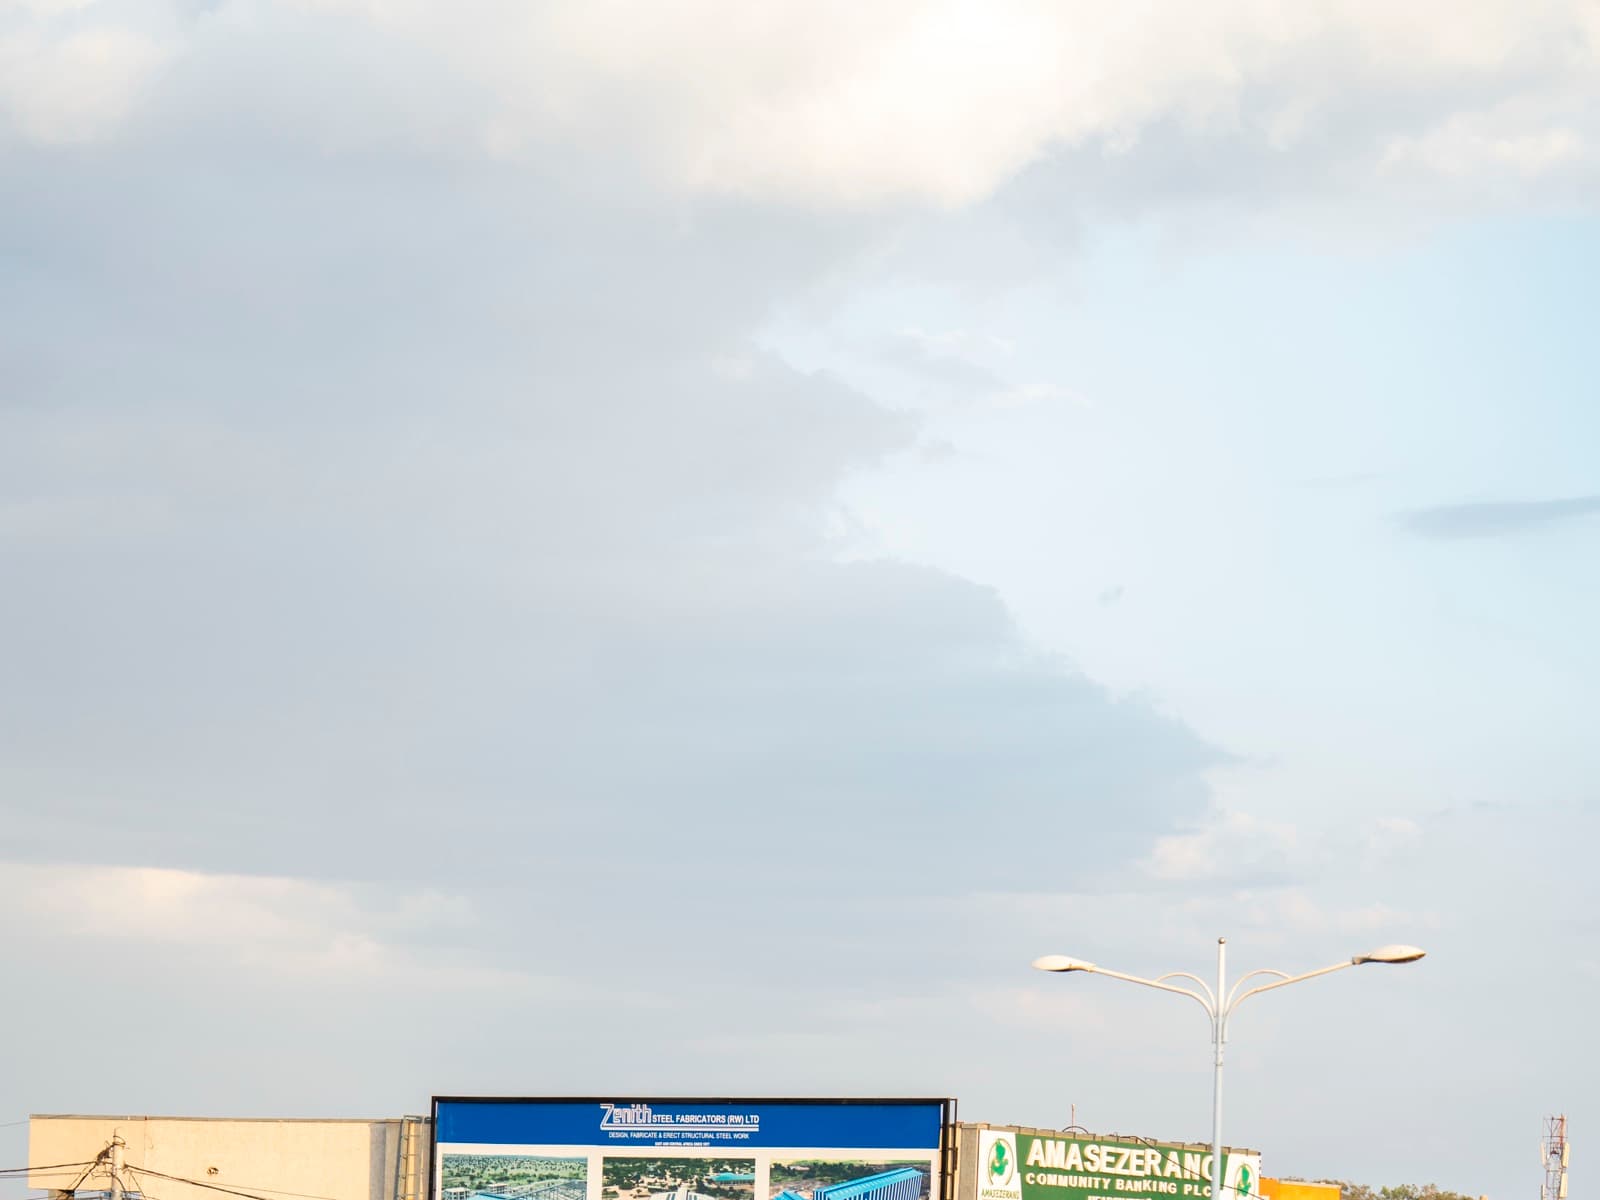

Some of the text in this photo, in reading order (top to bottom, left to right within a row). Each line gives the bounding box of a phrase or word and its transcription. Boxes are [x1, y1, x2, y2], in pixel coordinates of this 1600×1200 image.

[600, 1103, 759, 1128] Zenith STEEL FABRICATORS (RW) LTD
[1025, 1172, 1212, 1198] COMMUNITY BANKING PLC
